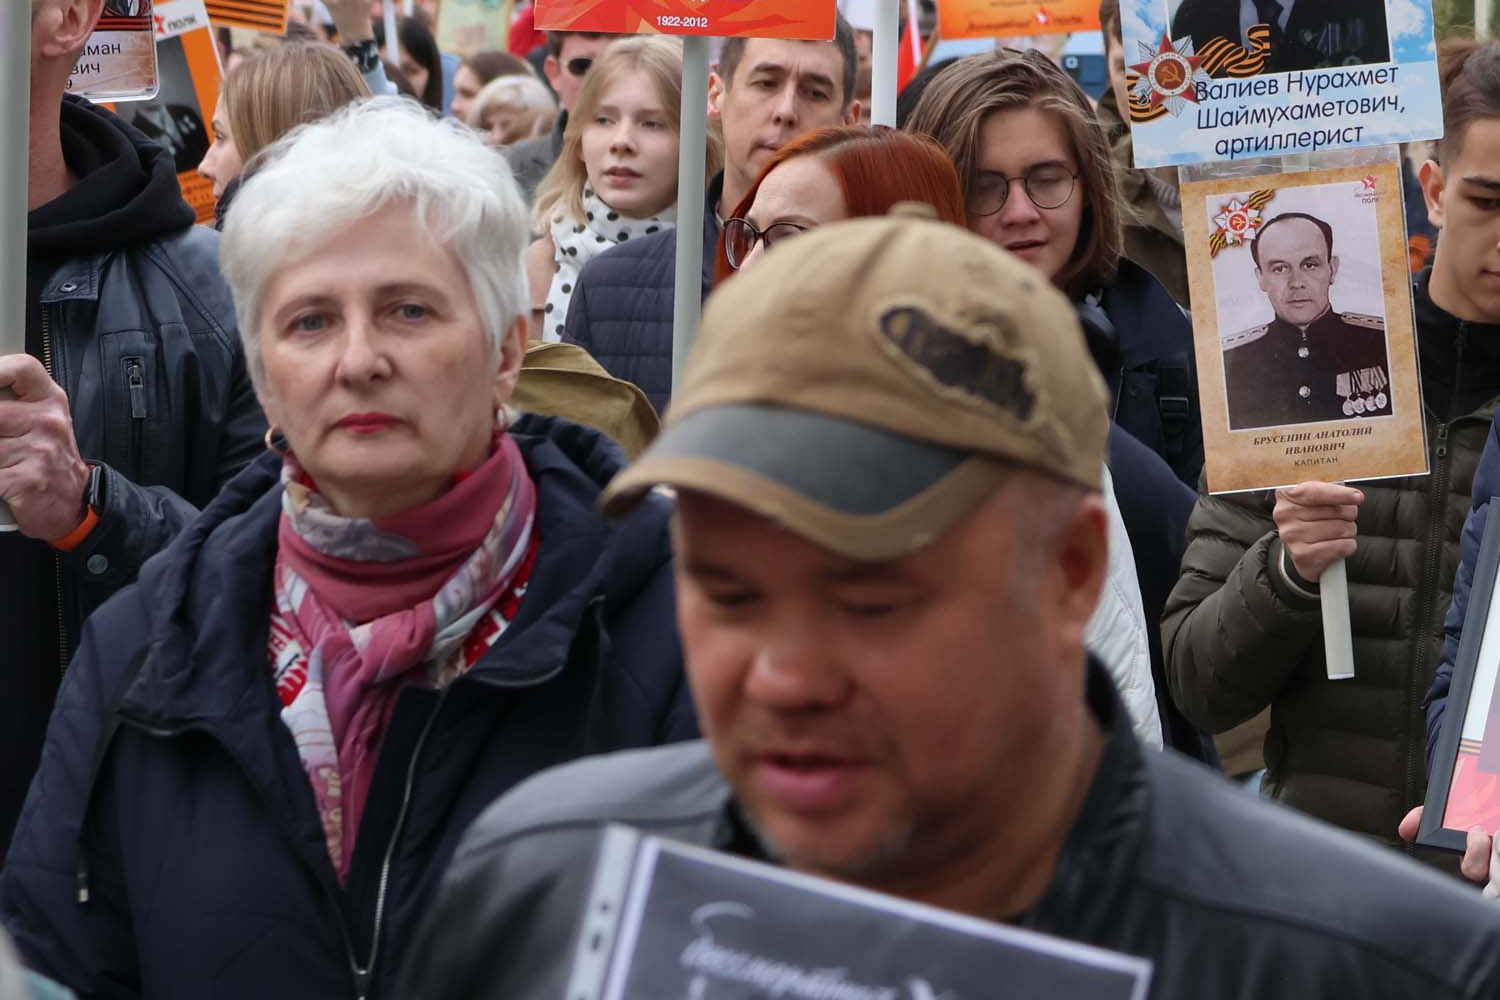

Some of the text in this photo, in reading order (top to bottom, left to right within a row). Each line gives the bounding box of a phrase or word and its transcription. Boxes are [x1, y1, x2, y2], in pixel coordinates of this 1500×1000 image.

[656, 15, 709, 28] 1922-2012
[1195, 66, 1400, 102] Валиев Нурахмет
[1196, 95, 1406, 130] Шаймухаметович,
[1214, 126, 1365, 160] артиллерист
[1253, 426, 1373, 446] БРУСЕНИН АНАТОЛИЙ
[1285, 442, 1346, 456] ИВАНОВИЧ
[1294, 456, 1339, 467] КАПИТАН
